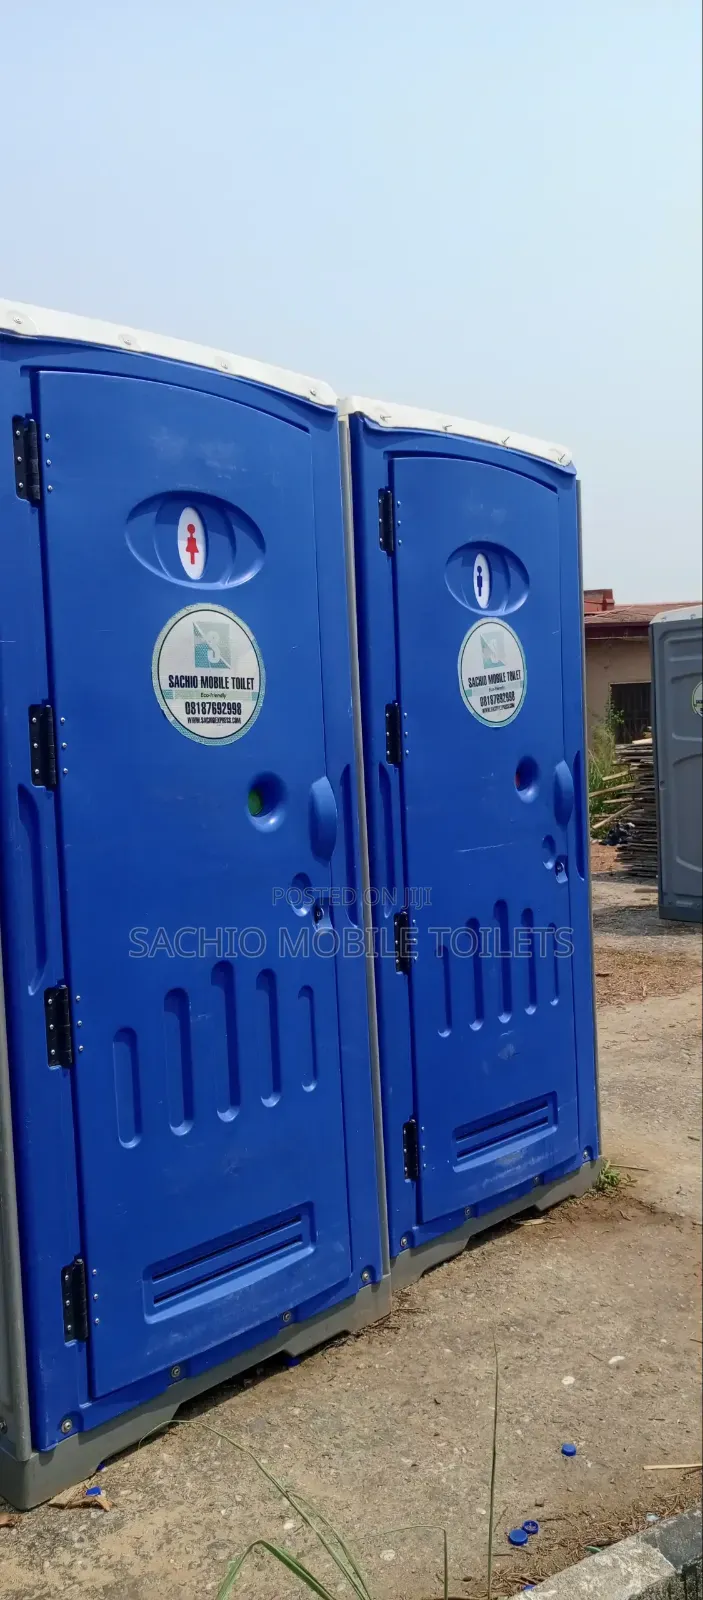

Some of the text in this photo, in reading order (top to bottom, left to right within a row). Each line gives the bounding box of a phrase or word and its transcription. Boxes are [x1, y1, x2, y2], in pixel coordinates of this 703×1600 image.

[169, 675, 254, 690] SACHIO MOBILE TOILET
[468, 669, 521, 688] SACHIO MOBILE TOILET
[185, 702, 241, 715] 08187692998
